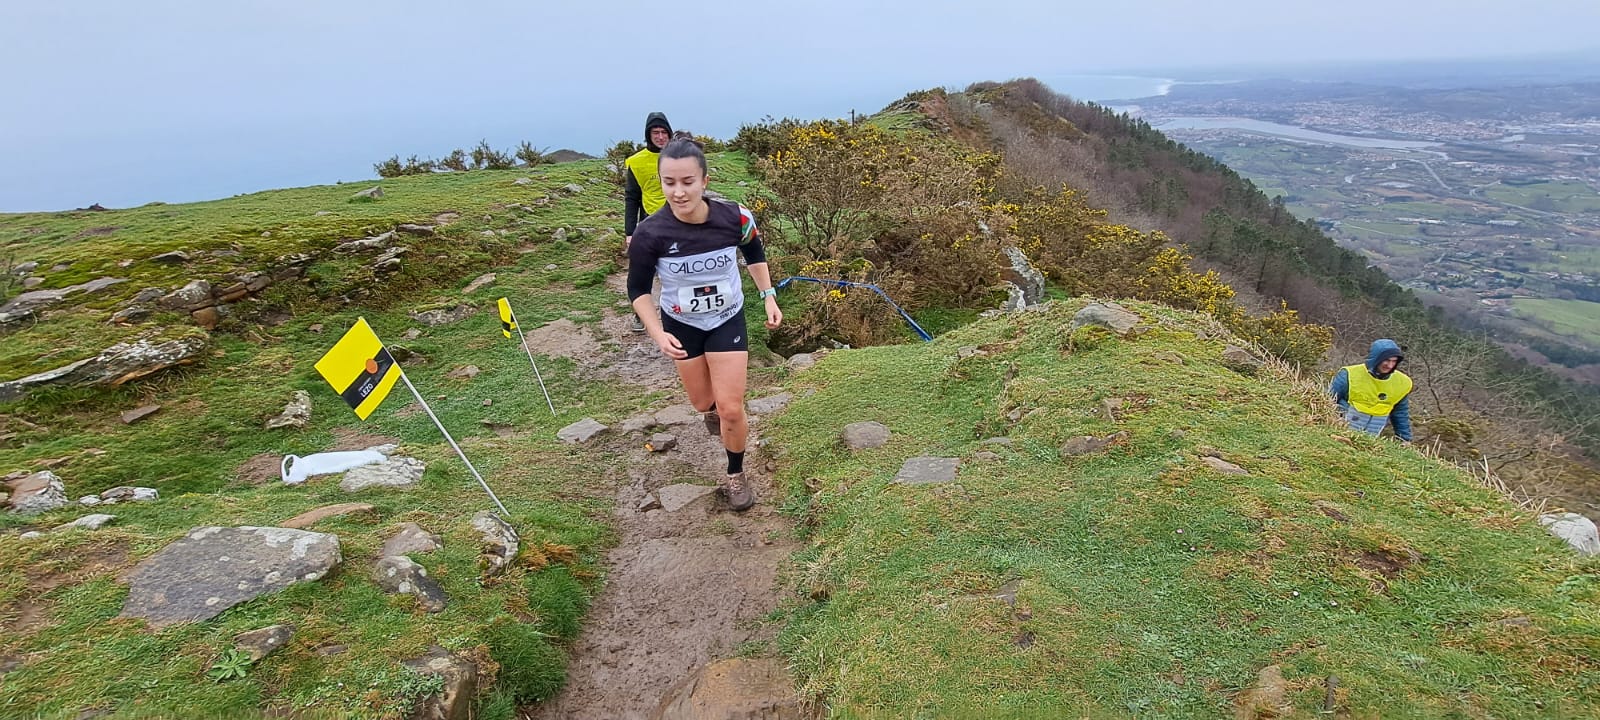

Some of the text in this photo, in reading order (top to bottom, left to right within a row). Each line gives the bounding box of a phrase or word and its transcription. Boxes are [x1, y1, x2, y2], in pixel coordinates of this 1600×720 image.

[669, 254, 732, 274] CALCOSA
[690, 295, 725, 312] 215
[360, 383, 374, 398] LEZO
